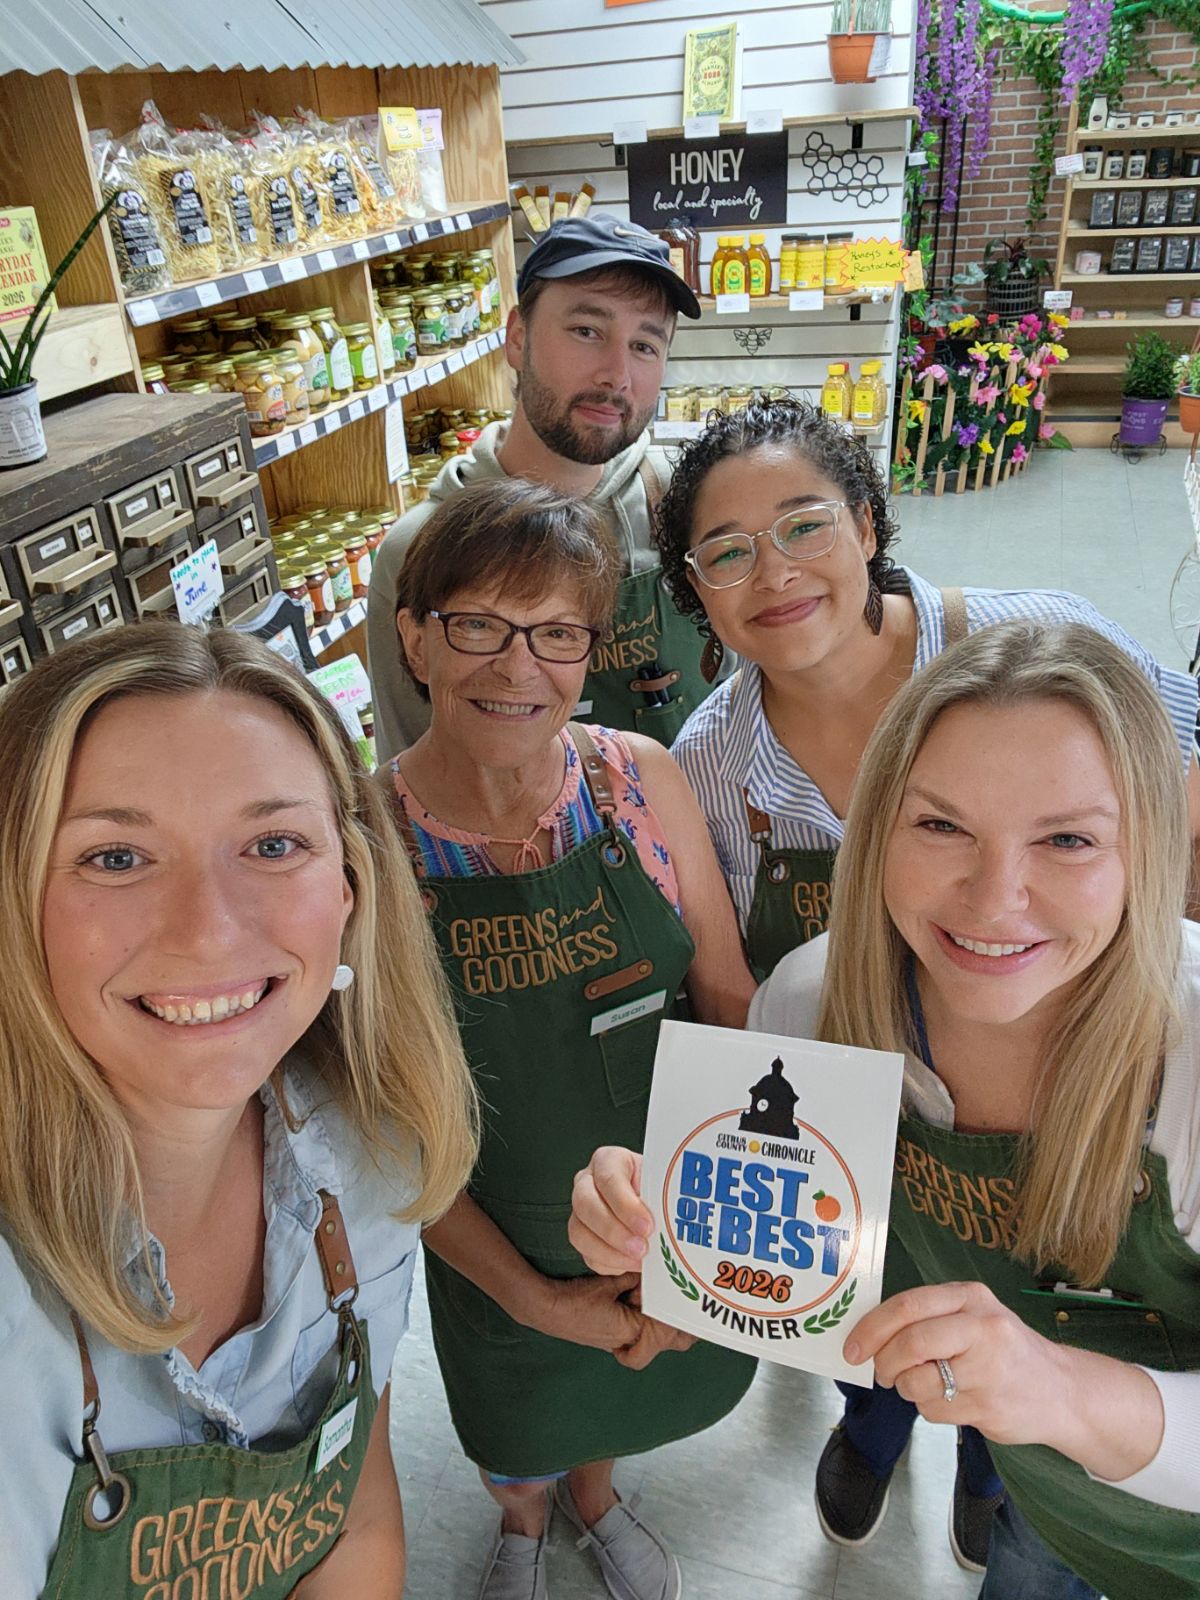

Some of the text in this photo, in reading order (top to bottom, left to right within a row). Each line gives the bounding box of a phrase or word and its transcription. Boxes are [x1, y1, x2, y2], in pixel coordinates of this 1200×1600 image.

[670, 148, 745, 185] HONEY
[653, 185, 764, 220] local and specialty
[0, 268, 37, 290] ENDAR
[184, 581, 207, 606] June
[617, 605, 661, 635] and
[589, 635, 658, 673] DNESS
[450, 886, 616, 957] GREENS and
[463, 924, 618, 995] GOODNESS
[610, 1004, 646, 1023] Susan
[716, 1140, 748, 1153] COUNTY
[717, 1133, 747, 1145] CITRUS
[761, 1141, 816, 1165] CHRONICLE
[680, 1150, 809, 1218] BEST
[895, 1136, 1017, 1217] GREENS
[676, 1197, 716, 1224] OF
[902, 1176, 1021, 1250] GOODN
[675, 1218, 713, 1248] THE
[718, 1205, 850, 1277] BEST
[713, 1261, 794, 1303] 2026
[701, 1293, 802, 1340] WINNER
[130, 1481, 300, 1585] GREENS
